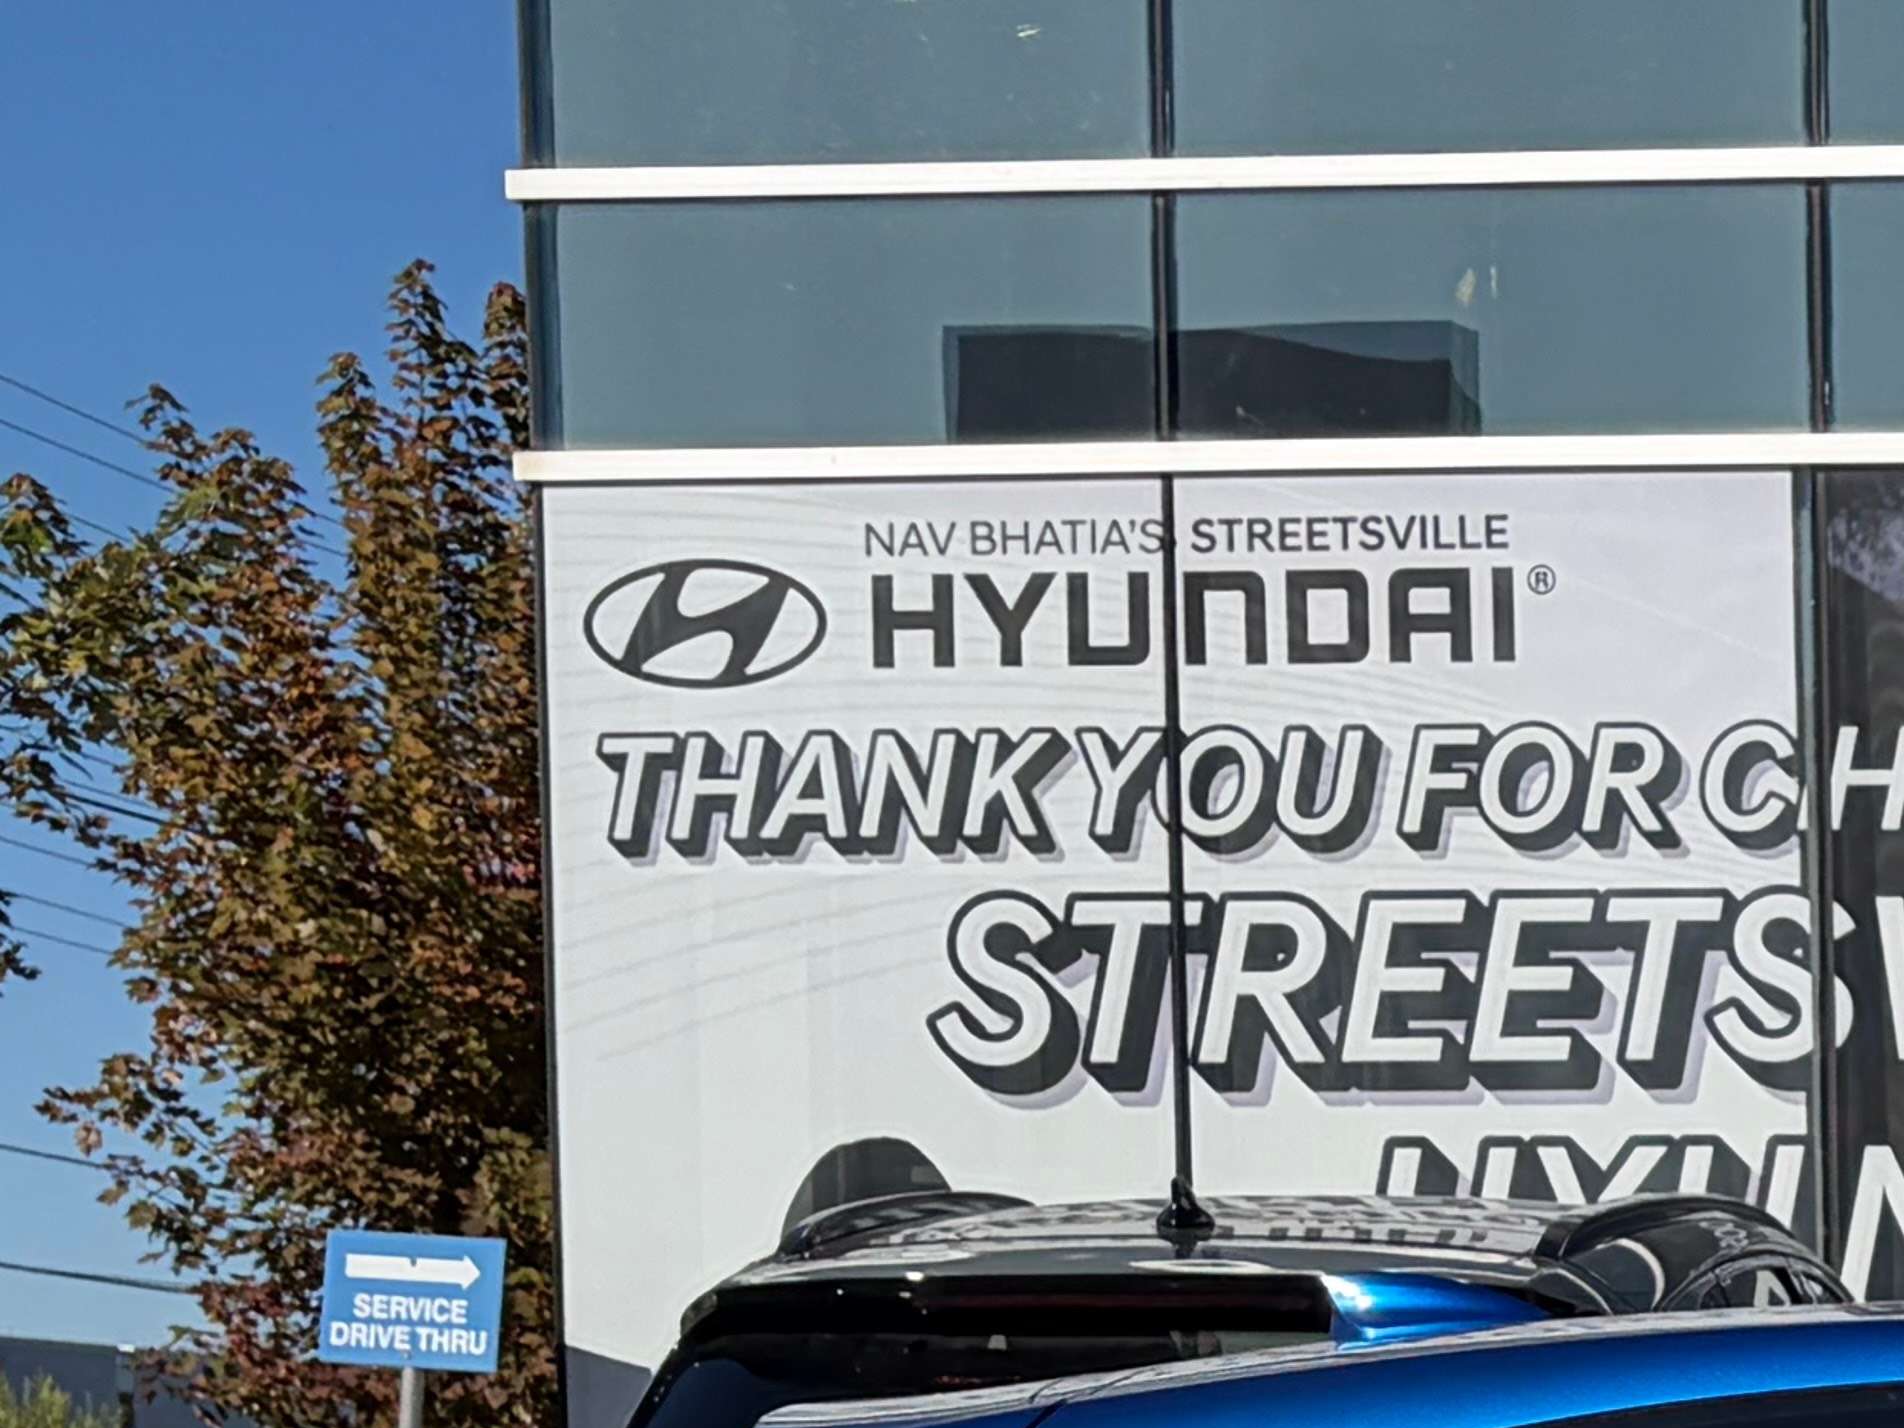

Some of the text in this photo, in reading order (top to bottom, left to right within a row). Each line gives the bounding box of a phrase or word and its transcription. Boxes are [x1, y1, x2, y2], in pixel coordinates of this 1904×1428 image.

[864, 513, 1510, 557] NAV BHATIA'S STREETSVILLE
[597, 728, 1068, 855] THANK
[1076, 723, 1385, 855] YOU
[1399, 721, 1685, 855] FOR
[353, 1292, 469, 1324] SERVICE
[329, 1321, 488, 1355] DRIVE THRU
